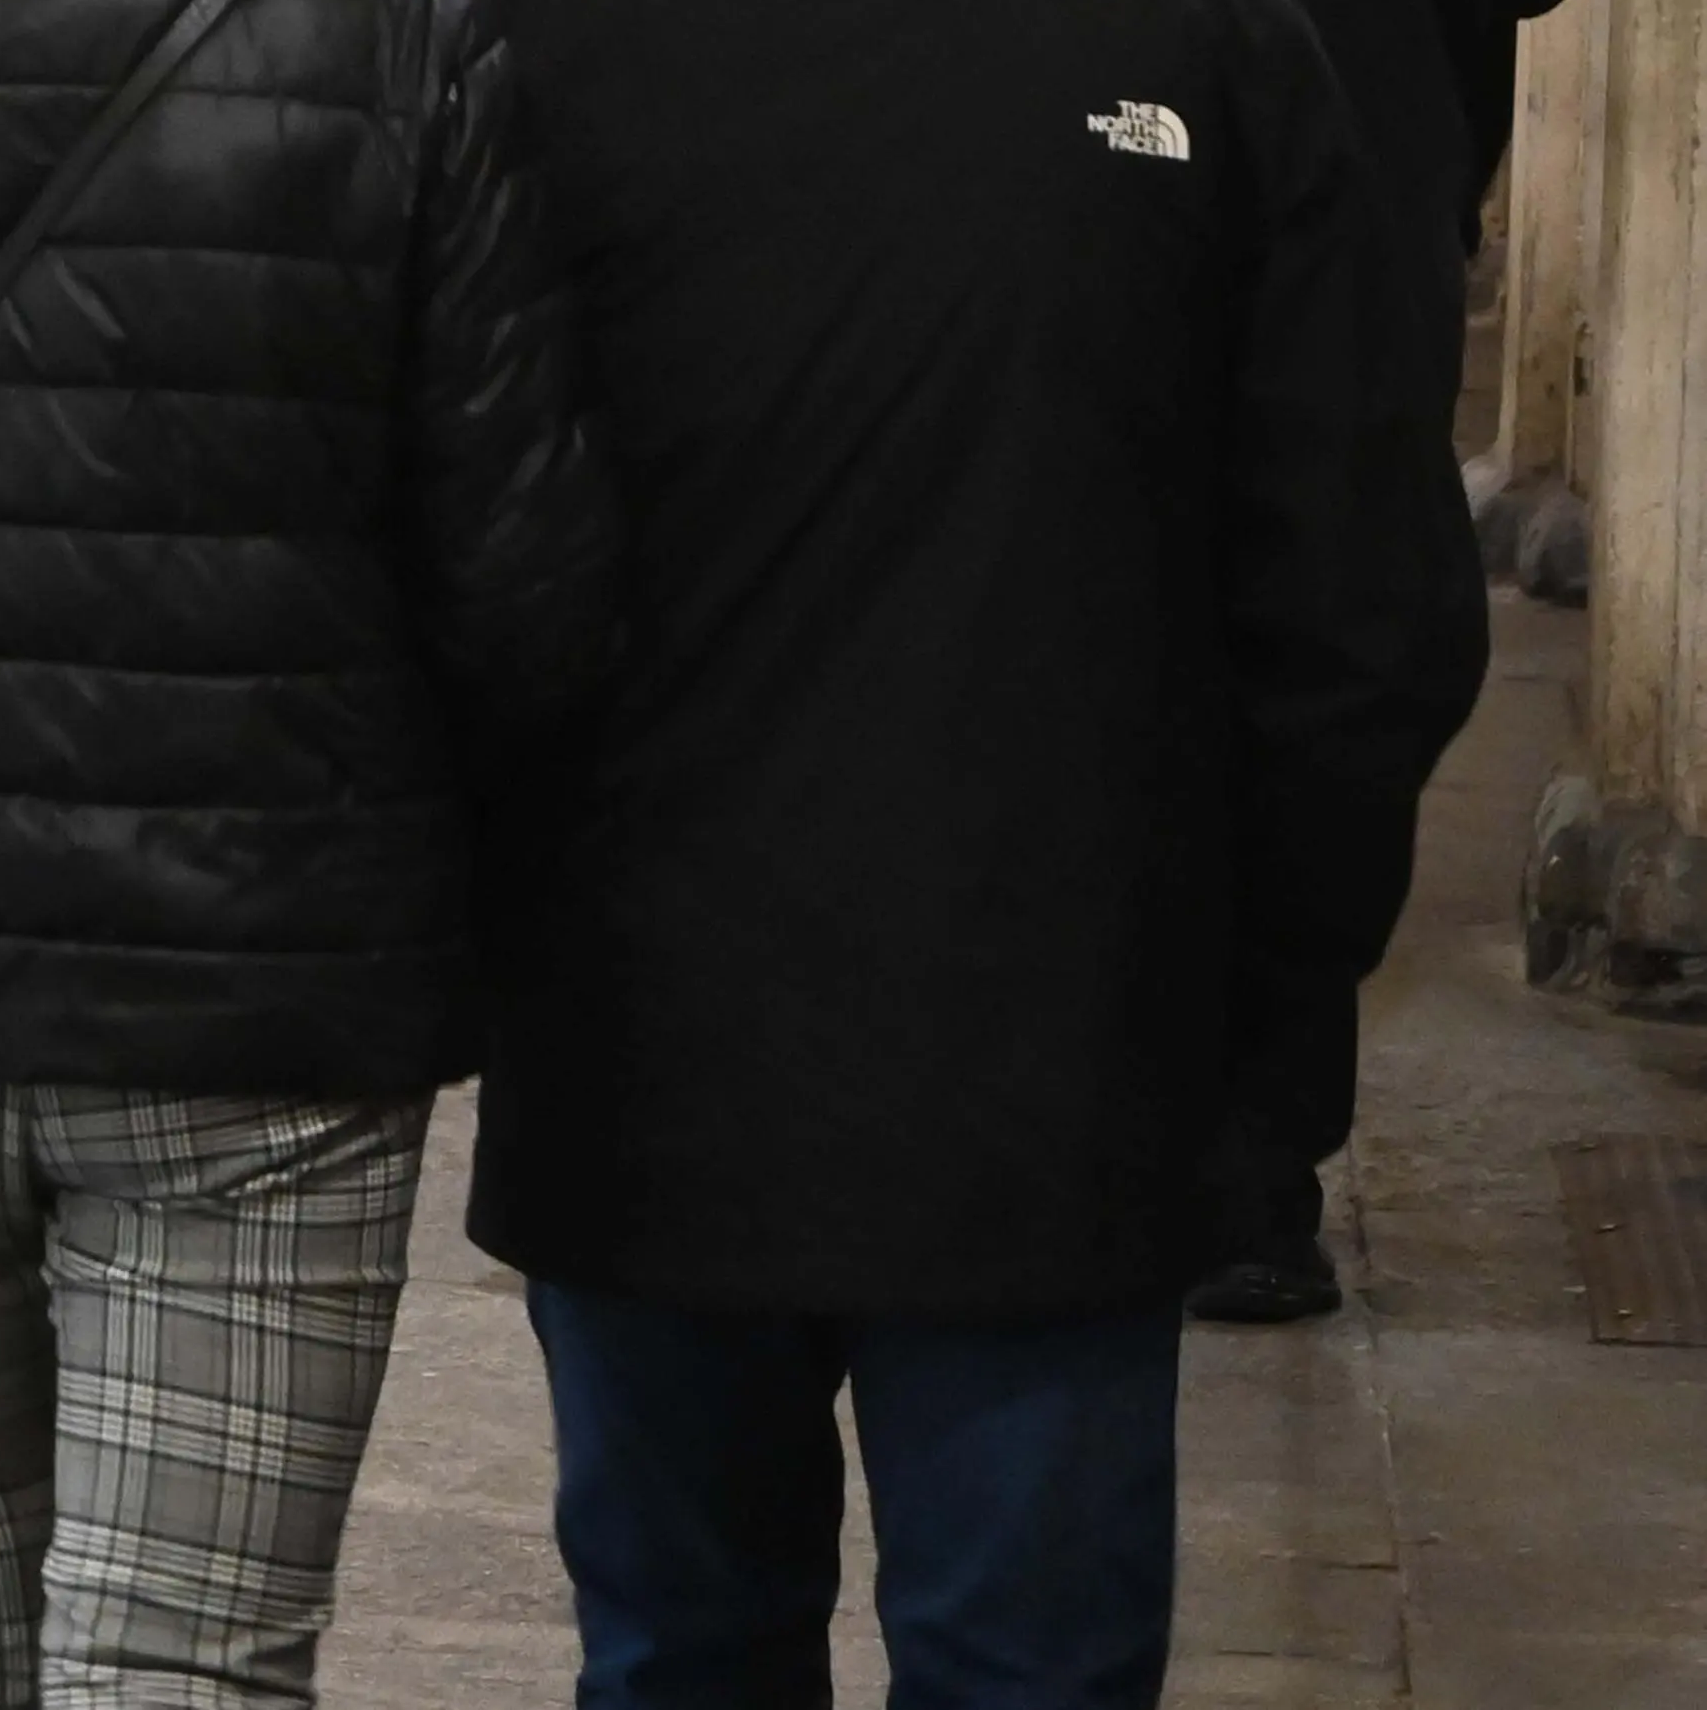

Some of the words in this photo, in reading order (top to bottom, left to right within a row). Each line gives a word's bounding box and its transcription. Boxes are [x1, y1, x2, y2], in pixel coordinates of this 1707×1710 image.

[1117, 99, 1157, 122] THE
[1087, 113, 1158, 139] NORTH
[1107, 131, 1158, 156] FACE
